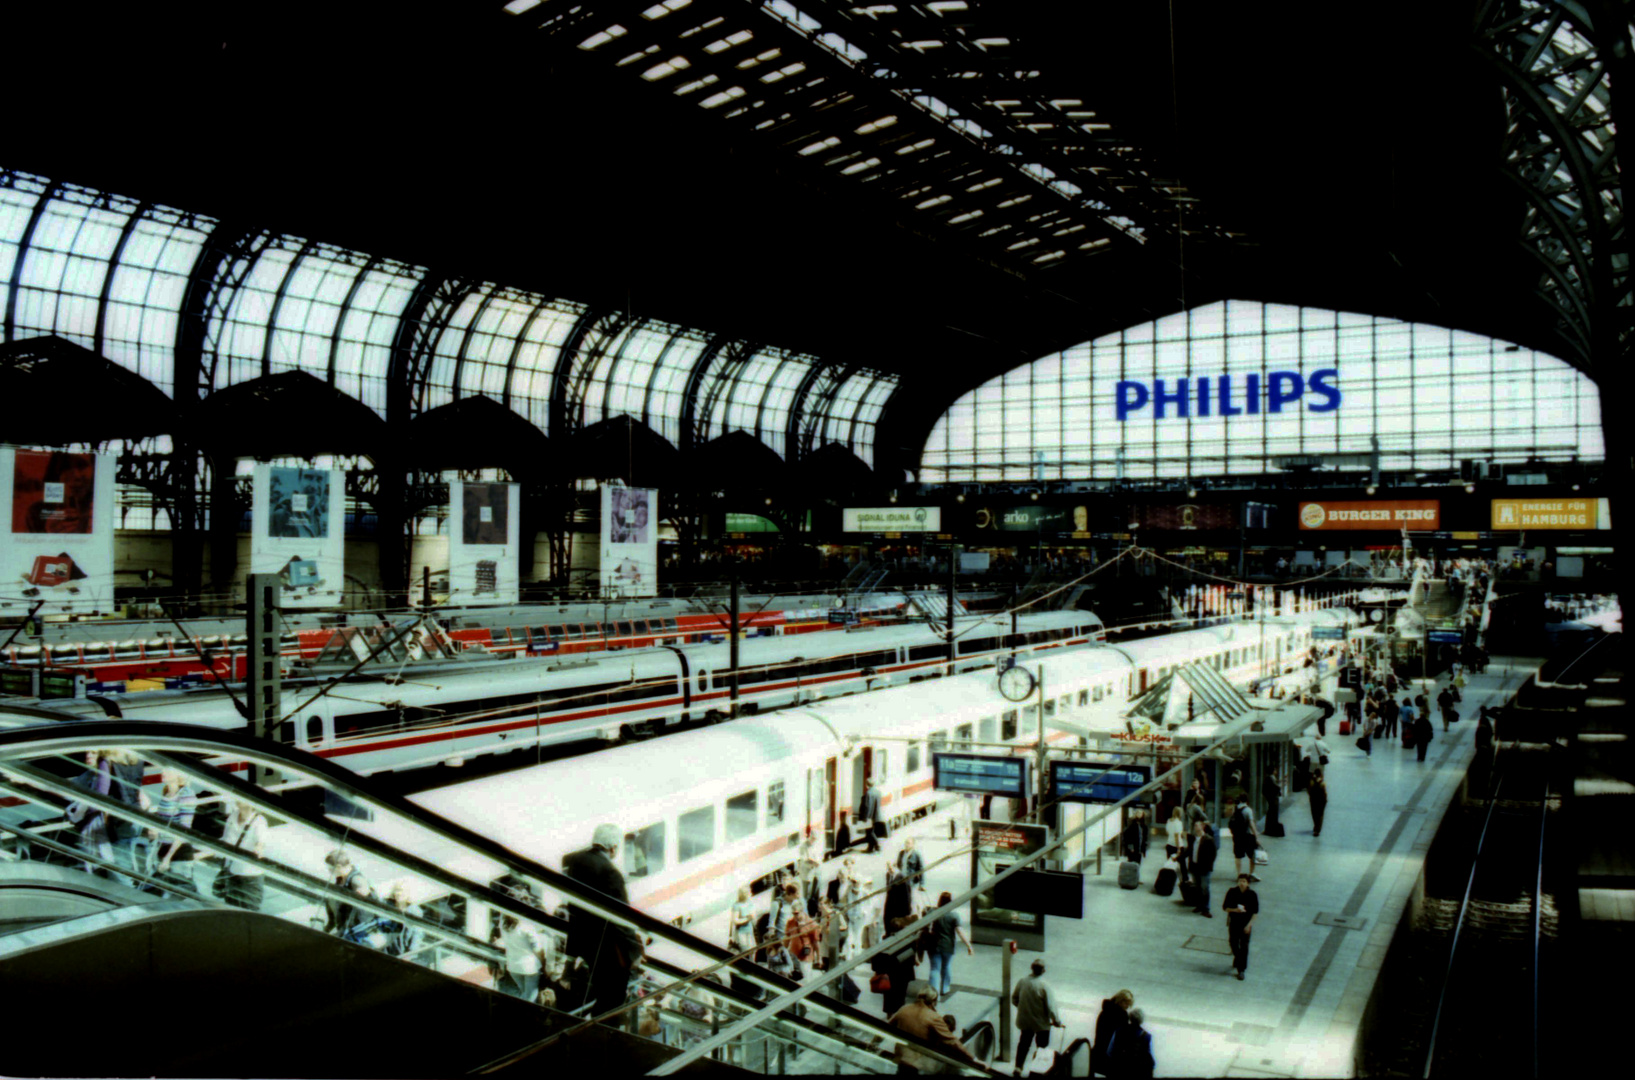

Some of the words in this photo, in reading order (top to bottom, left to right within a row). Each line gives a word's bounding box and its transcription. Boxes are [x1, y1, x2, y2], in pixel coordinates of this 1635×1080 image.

[1115, 368, 1343, 422] PHILIPS
[1522, 503, 1563, 511] ENERGIE
[1567, 501, 1586, 511] FÜR
[857, 513, 885, 522] SIGNAL
[886, 513, 911, 521] IDUNA
[1003, 510, 1029, 522] arko
[1328, 509, 1391, 521] BURGER
[1394, 509, 1436, 520] KING
[1522, 514, 1586, 525] HAMBURG
[1347, 668, 1358, 684] E
[1119, 731, 1160, 744] KIOSK
[1128, 771, 1144, 783] 12a
